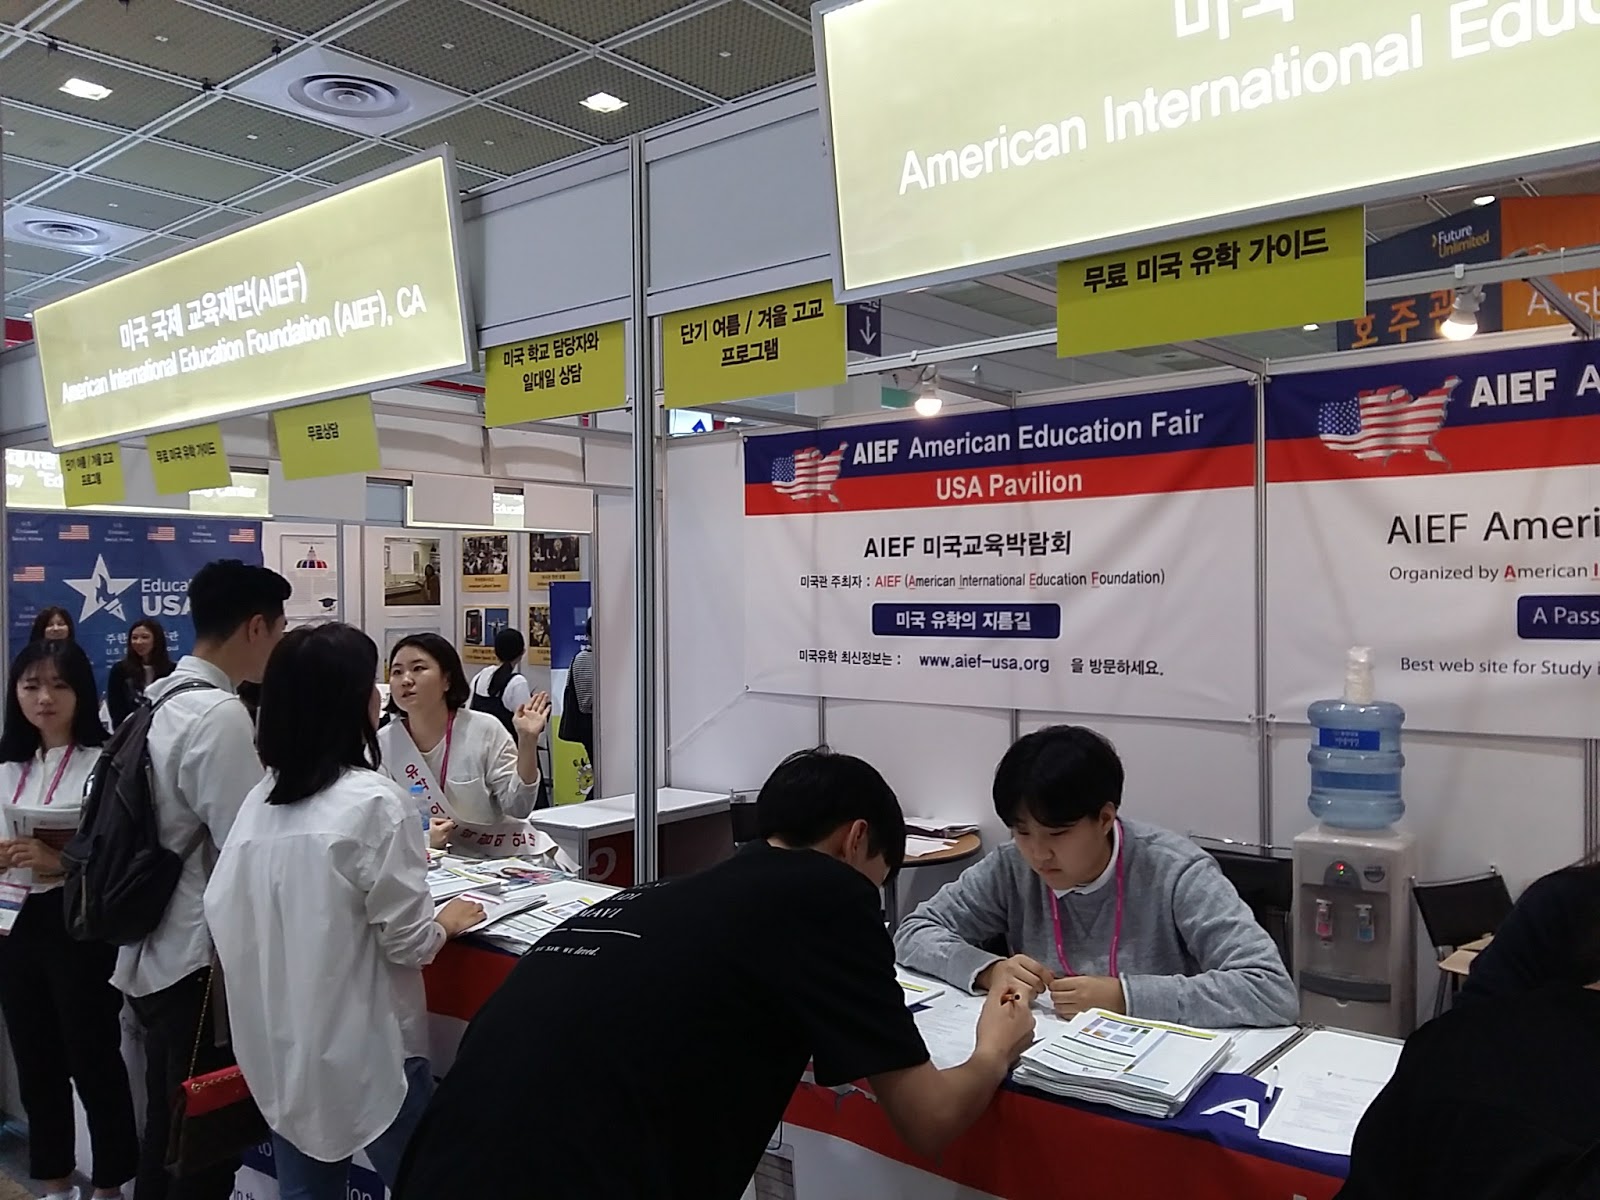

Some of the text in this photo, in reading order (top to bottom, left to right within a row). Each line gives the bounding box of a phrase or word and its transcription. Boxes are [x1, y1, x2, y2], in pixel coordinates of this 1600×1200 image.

[899, 114, 1087, 195] American
[1104, 28, 1424, 137] International
[1438, 225, 1473, 245] Future
[1438, 230, 1490, 258] Unlimited
[1083, 226, 1329, 294] 무료 미국 유학 가이드
[119, 261, 309, 352] 미국 국제 교육재단(AIEF)
[681, 298, 824, 345] 단기 여름 / 겨울 고교
[61, 283, 427, 405] American International Education Foundation (AIEF), CA
[503, 330, 599, 368] 미국 학교 담당자와
[721, 337, 779, 366] 프로그램
[522, 363, 582, 392] 일대일 상담
[1470, 368, 1557, 408] AIEF
[306, 421, 340, 442] 무료상담
[853, 409, 1204, 465] AIEF American Education Fair
[936, 470, 1083, 501] USA Pavilion
[1387, 506, 1600, 545] AIEF Ameri
[864, 530, 1072, 559] AIEF 미국교육박람회
[141, 578, 192, 592] Educa
[800, 575, 828, 589] 미국관
[831, 574, 862, 589] 주최자
[875, 575, 902, 588] AIEF
[905, 573, 956, 589] (American
[958, 572, 1026, 589] International
[1029, 571, 1087, 589] Education
[1091, 569, 1165, 588] Foundation)
[1389, 565, 1473, 584] Organized
[1478, 566, 1499, 583] by
[1504, 564, 1588, 580] American
[896, 610, 1031, 631] 미국 유학의 지름길
[1533, 606, 1600, 625] A Pass
[799, 649, 838, 665] 미국유학
[841, 651, 893, 667] 최신정보는
[919, 654, 1050, 673] www.aief-usa.org
[1071, 658, 1084, 674] 을
[1089, 659, 1164, 676] 방문하세요.
[1401, 658, 1436, 672] Best
[1439, 658, 1474, 673] web
[1479, 659, 1508, 674] site
[1513, 659, 1536, 674] for
[1541, 660, 1592, 679] Study
